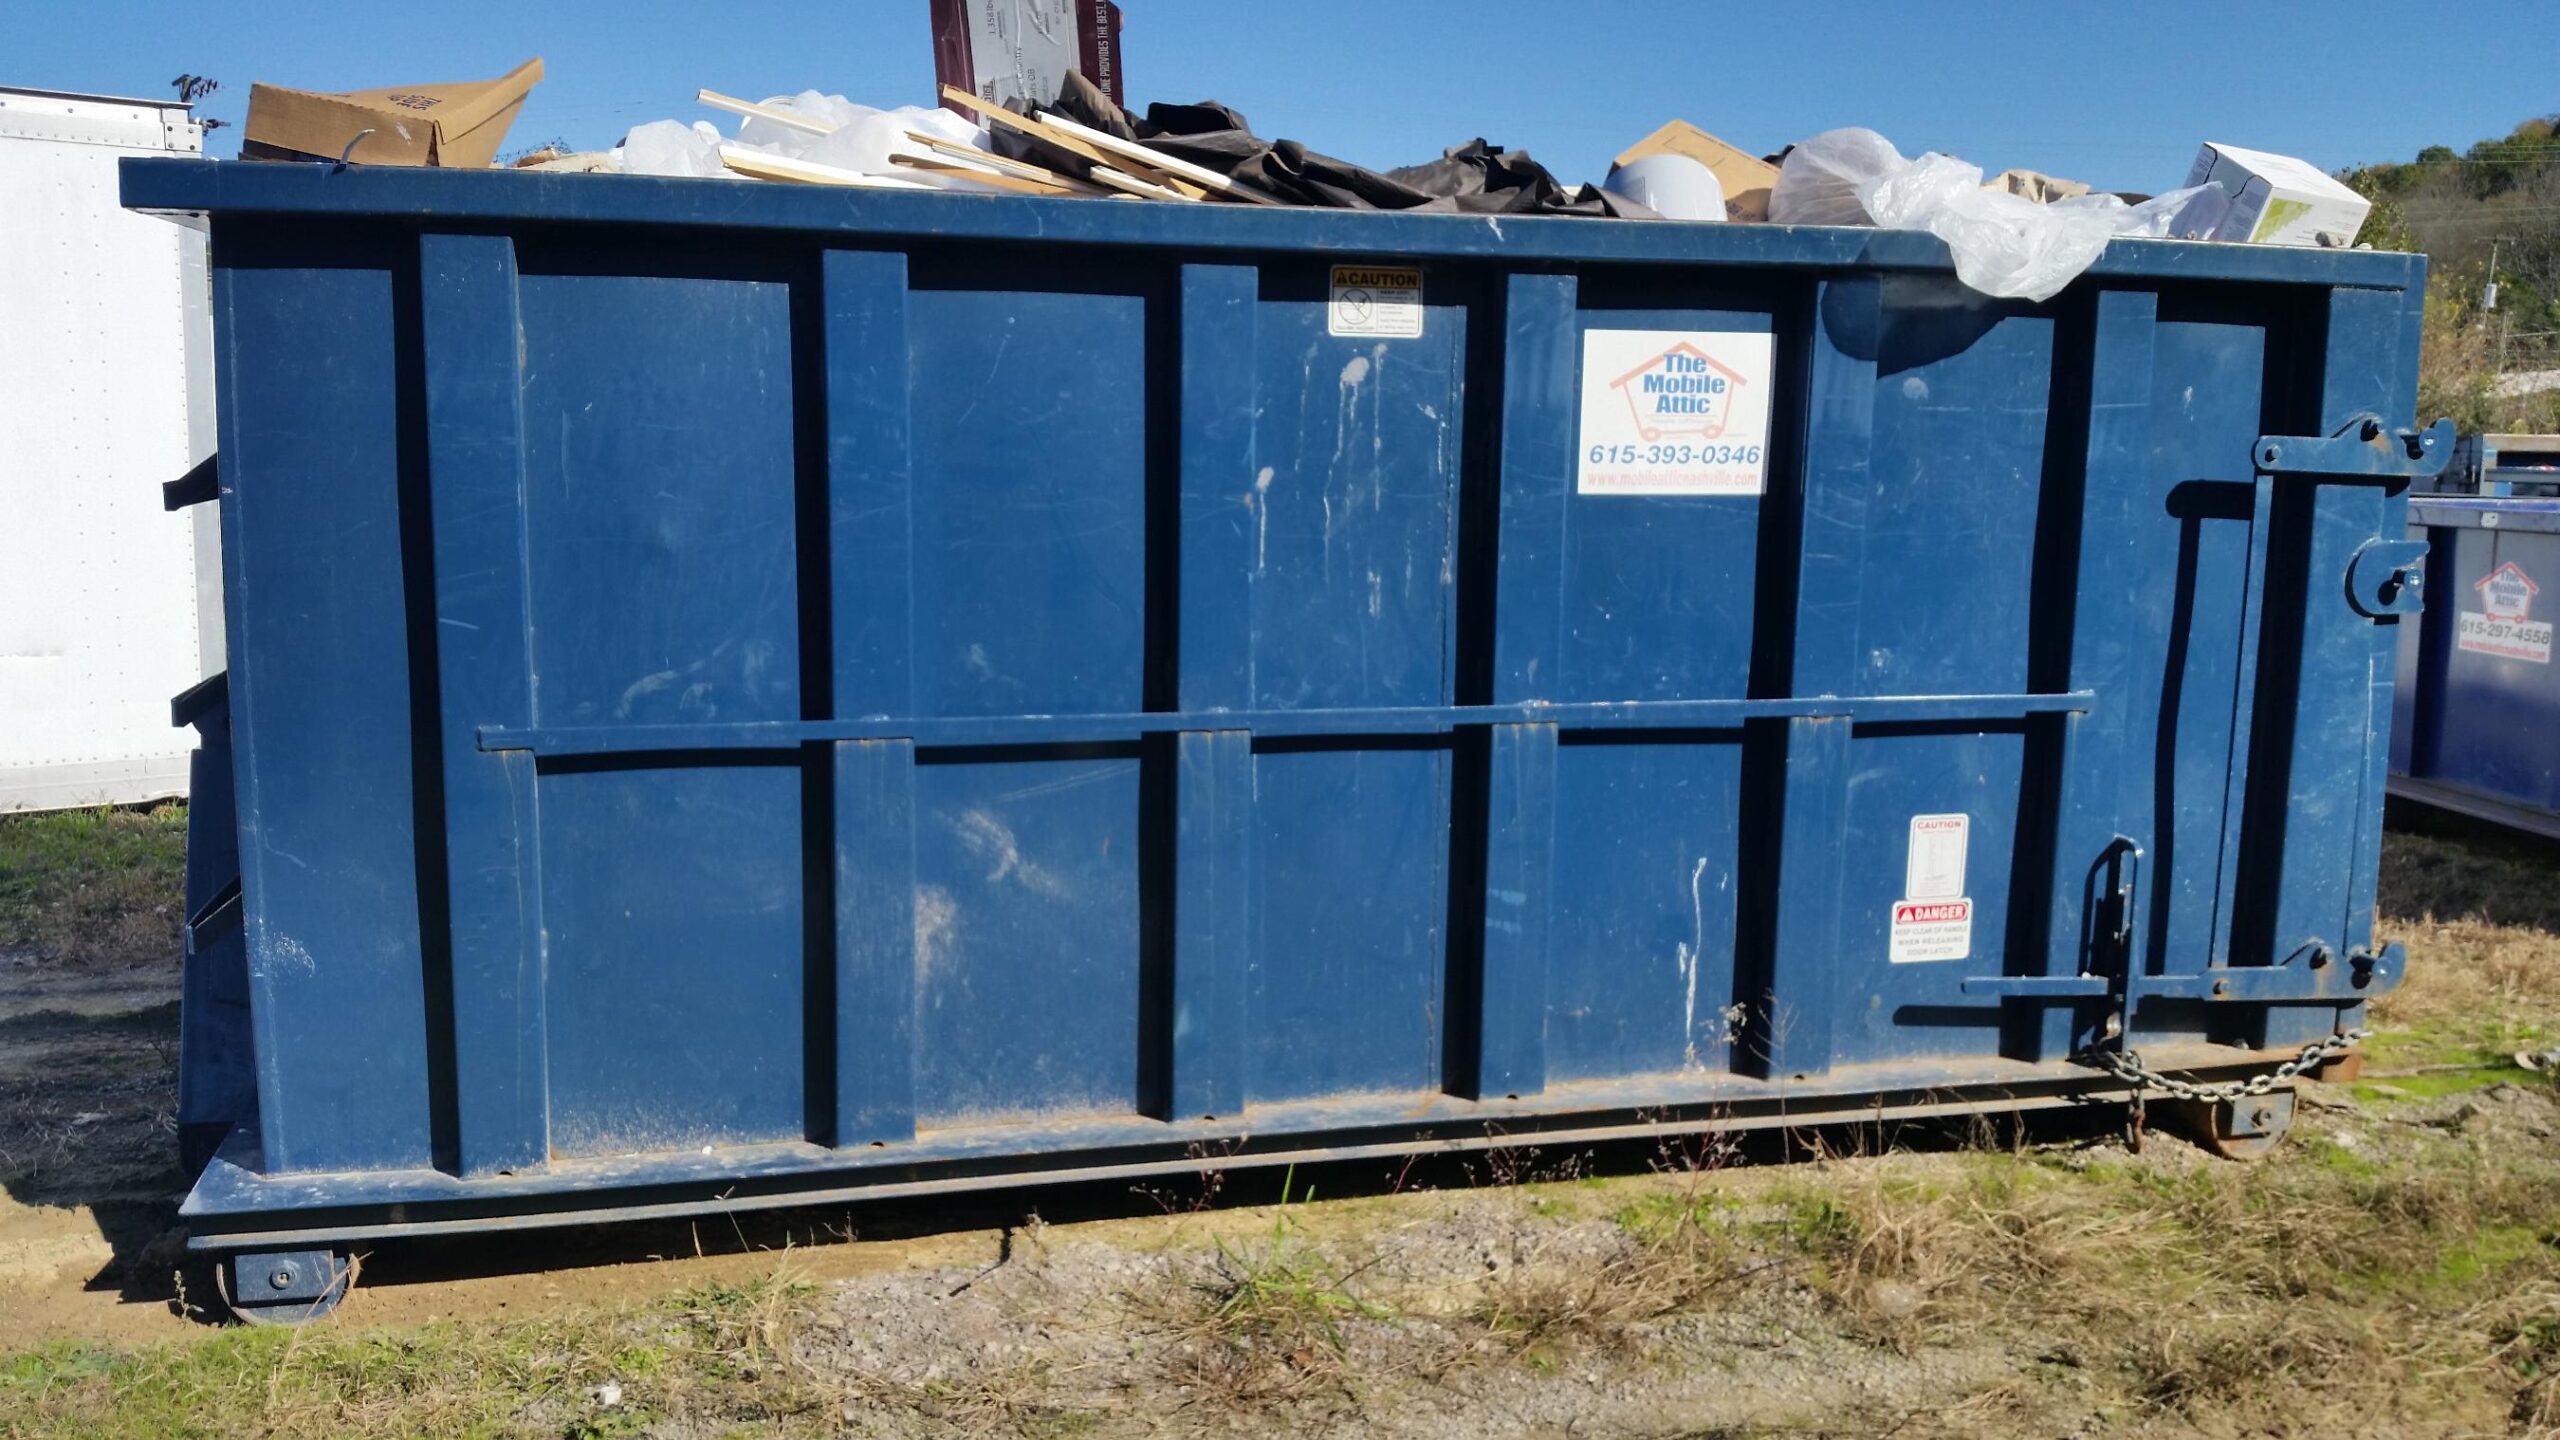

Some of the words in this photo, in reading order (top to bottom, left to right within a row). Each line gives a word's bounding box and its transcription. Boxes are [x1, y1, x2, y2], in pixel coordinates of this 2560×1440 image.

[1096, 26, 1108, 39] THE
[1097, 40, 1111, 77] PROVIDES
[1348, 272, 1417, 286] CAUTION
[1663, 353, 1707, 373] The
[1643, 374, 1725, 394] Mobile
[1656, 394, 1711, 414] Attic
[1589, 444, 1761, 465] 615-393-0346
[2461, 619, 2551, 645] 615-297-4558
[1917, 820, 1961, 830] CAUTION
[1914, 905, 1964, 921] DANGER
